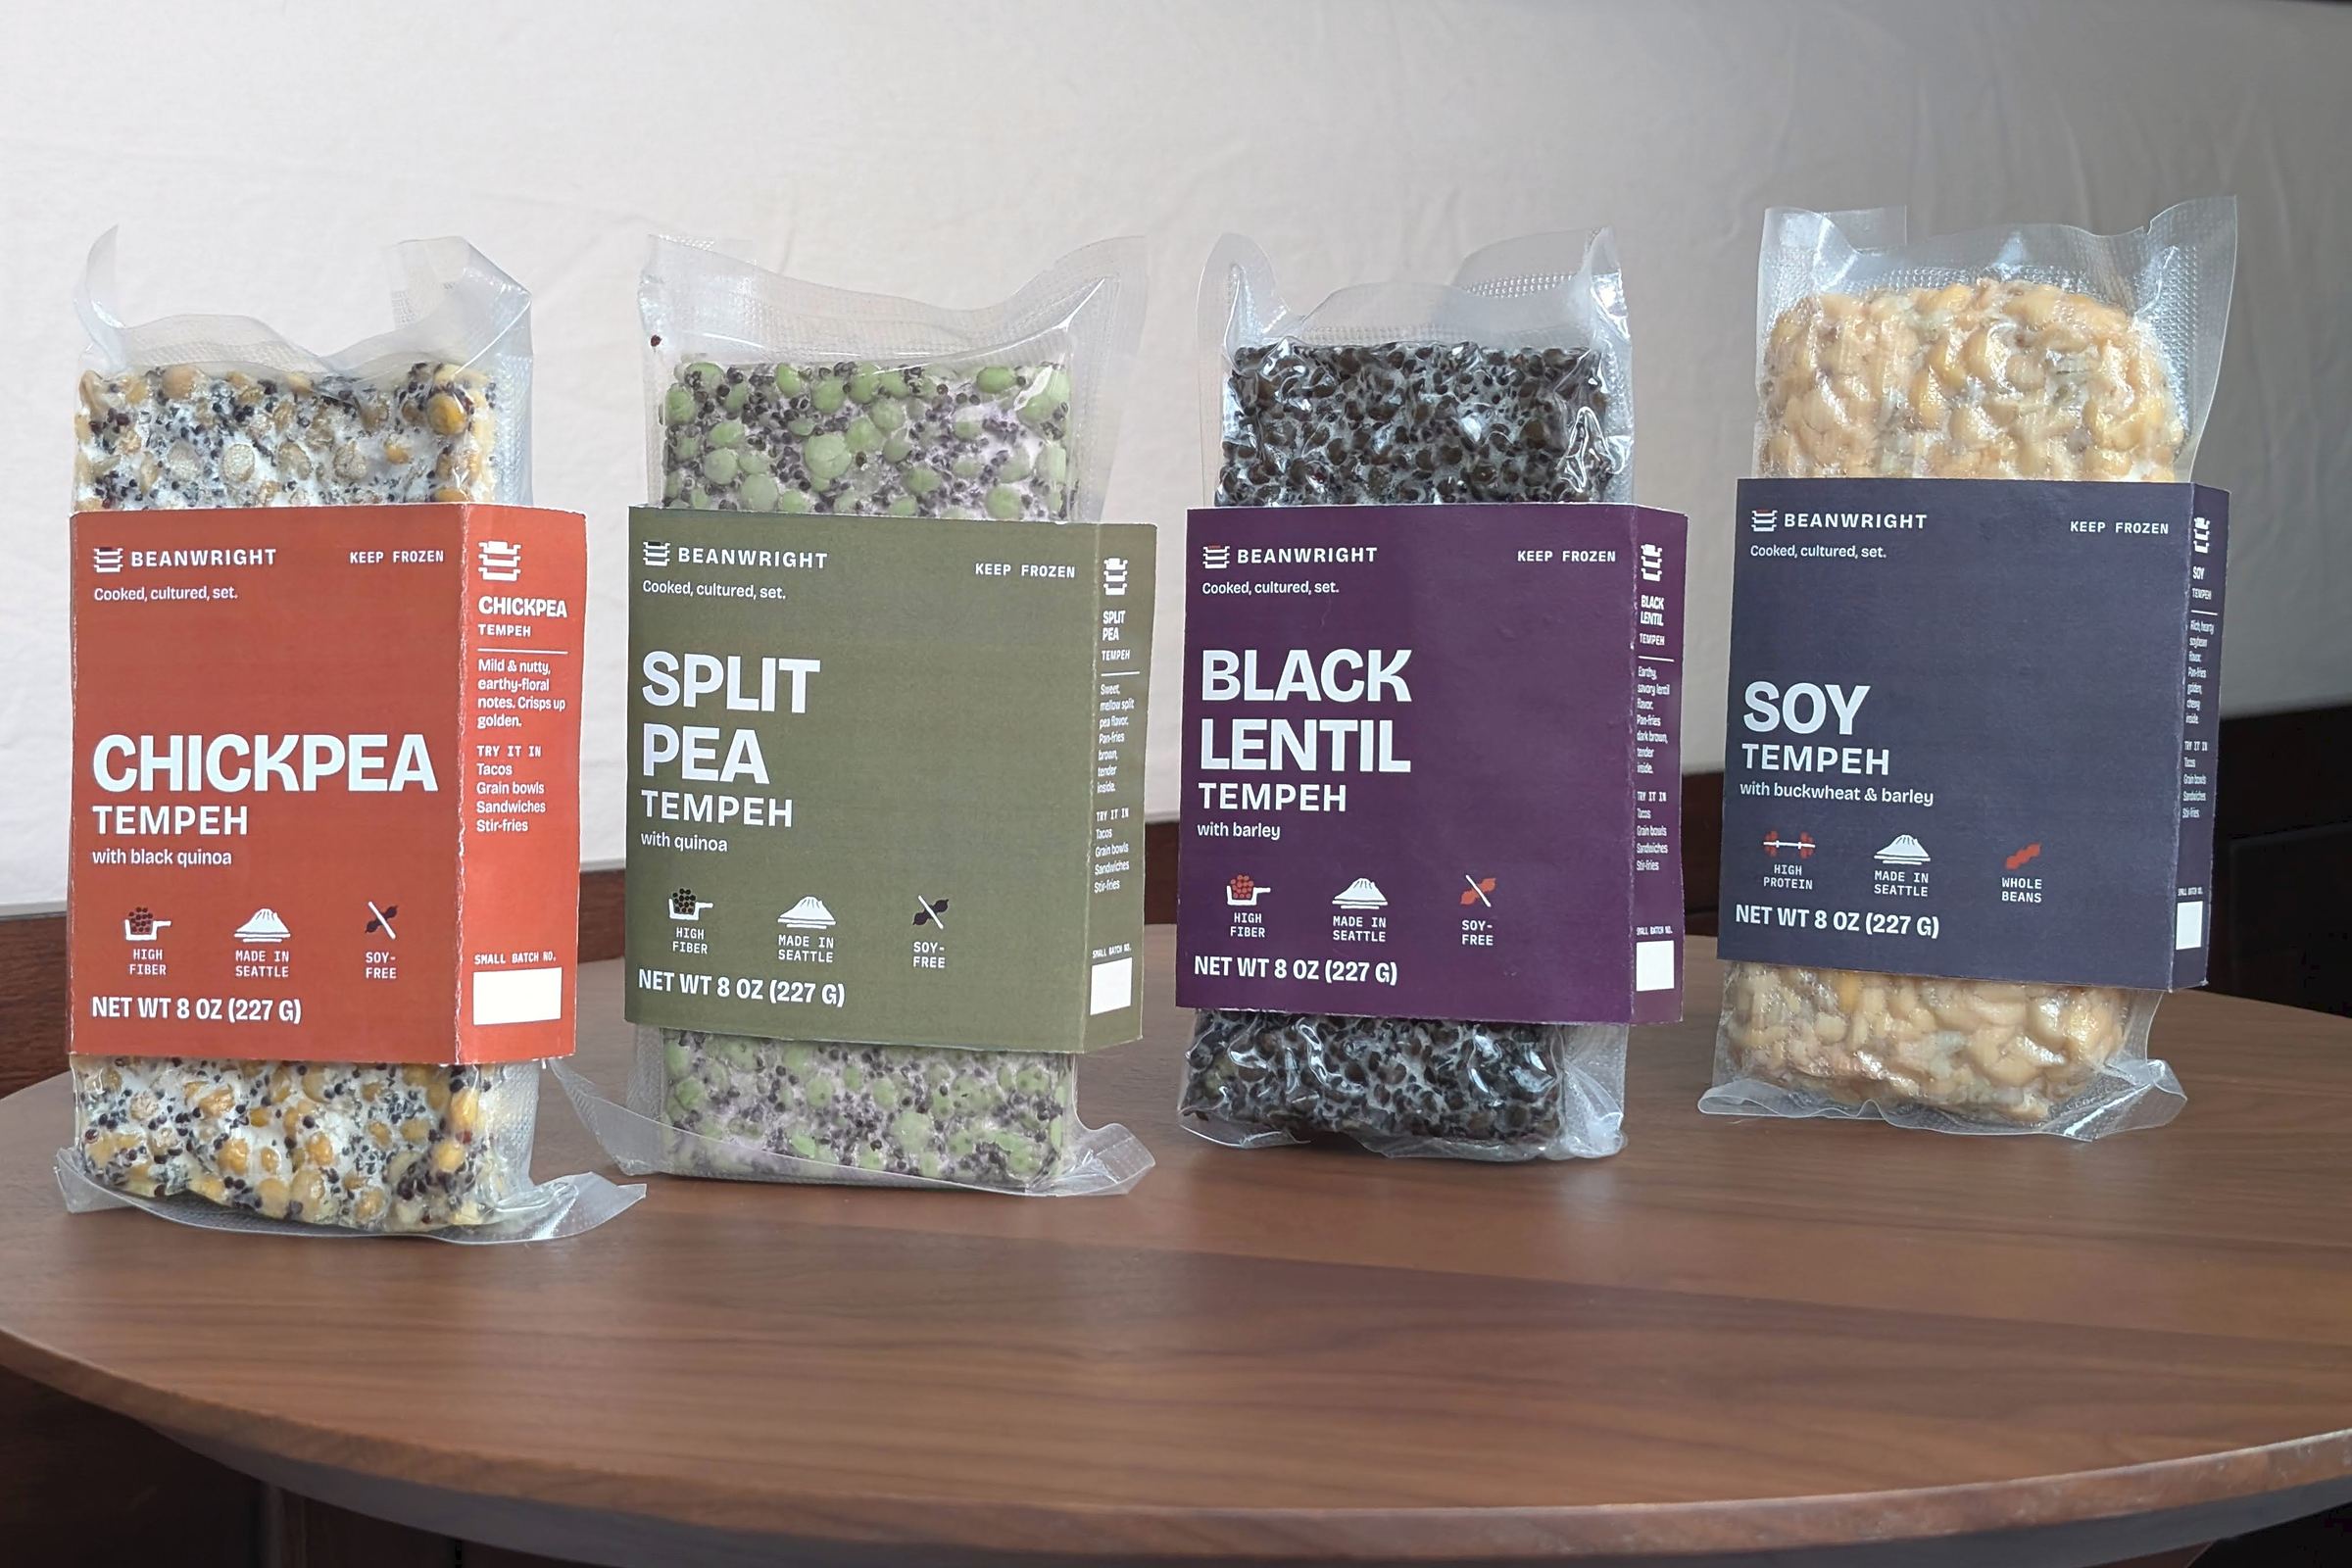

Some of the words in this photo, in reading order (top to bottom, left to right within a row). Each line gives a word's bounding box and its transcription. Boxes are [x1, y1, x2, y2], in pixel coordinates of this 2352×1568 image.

[1785, 514, 1927, 528] BEANWRIGHT
[2071, 521, 2105, 532] KEEP
[2116, 522, 2168, 534] FROZEN
[131, 549, 275, 566] BEANWRIGHT
[350, 552, 383, 564] KEEP
[393, 551, 443, 563] FROZEN
[679, 548, 827, 568] BEANWRIGHT
[1238, 548, 1377, 564] BEANWRIGHT
[1518, 551, 1552, 562] KEEP
[1563, 551, 1615, 562] FROZEN
[1751, 545, 1797, 558] Cooked,
[1801, 545, 1858, 559] cultured,
[1861, 547, 1886, 558] set.
[976, 564, 1010, 575] KEEP
[1021, 564, 1074, 577] FROZEN
[2193, 566, 2204, 579] SOY
[94, 587, 147, 602] Cooked,
[151, 586, 210, 601] cultured,
[213, 587, 237, 599] set.
[643, 580, 693, 596] Cooked,
[697, 583, 757, 600] cultured,
[760, 588, 785, 599] set.
[1202, 581, 1251, 595] Cooked,
[1254, 581, 1311, 595] cultured,
[1314, 582, 1339, 593] set.
[479, 596, 566, 617] CHICKPEA
[1642, 595, 1664, 610] BLACK
[1103, 611, 1125, 624] SPLIT
[1641, 612, 1663, 626] LENTIL
[478, 624, 530, 636] TEMPEH
[1102, 627, 1119, 641] PEA
[1102, 650, 1130, 661] TEMPEH
[479, 659, 505, 671] Mild
[508, 661, 516, 671] &
[519, 662, 550, 675] nutty,
[1202, 649, 1411, 702] BLACK
[478, 677, 549, 693] earthy-floral
[643, 652, 820, 713] SPLIT
[478, 697, 515, 709] notes.
[517, 696, 551, 710] Crisps
[554, 700, 565, 711] up
[1744, 681, 1870, 735] SOY
[477, 713, 521, 729] golden.
[477, 746, 500, 757] TRY
[508, 746, 521, 757] IT
[529, 746, 541, 757] IN
[1201, 719, 1410, 772] LENTIL
[644, 723, 769, 784] PEA
[1742, 744, 1888, 775] TEMPEH
[93, 734, 438, 792] CHICKPEA
[477, 763, 513, 775] Tacos
[476, 782, 509, 794] Grain
[513, 782, 544, 794] bowls
[1740, 781, 1770, 796] with
[1775, 783, 1860, 801] buckwheat
[1864, 788, 1877, 801] &
[1882, 788, 1933, 807] barley
[1199, 783, 1346, 811] TEMPEH
[477, 800, 545, 813] Sandwiches
[642, 790, 792, 827] TEMPEH
[92, 806, 247, 835] TEMPEH
[1110, 809, 1119, 819] IT
[477, 818, 527, 832] Stir-fries
[1198, 821, 1228, 836] with
[1233, 822, 1280, 840] barley
[1096, 829, 1112, 839] Tacos
[641, 831, 669, 847] with
[674, 835, 727, 852] quinoa
[92, 849, 125, 863] with
[131, 849, 172, 864] black
[177, 849, 231, 867] quinoa
[1775, 864, 1801, 875] HIGH
[1764, 877, 1812, 889] PROTEIN
[1875, 870, 1904, 881] MADE
[1914, 873, 1928, 883] IN
[2002, 878, 2041, 889] WHOLE
[1875, 884, 1928, 897] SEATTLE
[2002, 891, 2041, 903] BEANS
[1235, 912, 1261, 923] HIGH
[1333, 916, 1362, 927] MADE
[1372, 917, 1386, 927] IN
[1737, 905, 1772, 924] NET
[1778, 907, 1809, 927] WT
[1815, 910, 1827, 929] 8
[1834, 911, 1859, 931] OZ
[1866, 912, 1911, 935] (227
[1917, 916, 1938, 939] G)
[1231, 926, 1265, 937] FIBER
[1462, 920, 1492, 931] SOY-
[676, 927, 704, 940] HIGH
[1334, 930, 1385, 942] SEATTLE
[1462, 934, 1493, 946] FREE
[673, 941, 708, 954] FIBER
[779, 935, 809, 947] MADE
[819, 937, 833, 949] IN
[914, 942, 944, 954] SOY-
[133, 949, 162, 959] HIGH
[236, 951, 266, 961] MADE
[274, 951, 288, 961] IN
[366, 952, 395, 963] SOY-
[475, 954, 506, 964] SMALL
[512, 952, 539, 963] BATCH
[543, 952, 556, 960] NO.
[779, 950, 833, 962] SEATTLE
[913, 956, 945, 968] FREE
[130, 964, 166, 975] FIBER
[236, 965, 288, 977] SEATTLE
[367, 967, 396, 978] FREE
[1195, 956, 1232, 975] NET
[1238, 957, 1269, 977] WT
[1275, 959, 1287, 978] 8
[1294, 960, 1319, 979] OZ
[1325, 959, 1369, 983] (227
[1376, 962, 1396, 985] G)
[639, 969, 674, 991] NET
[680, 974, 711, 995] WT
[717, 977, 729, 997] 8
[737, 979, 762, 1000] OZ
[770, 980, 815, 1004] (227
[822, 984, 845, 1007] G)
[93, 997, 132, 1017] NET
[137, 998, 171, 1018] WT
[177, 999, 189, 1018] 8
[196, 999, 222, 1019] OZ
[228, 998, 272, 1022] (227
[279, 1000, 301, 1024] G)
